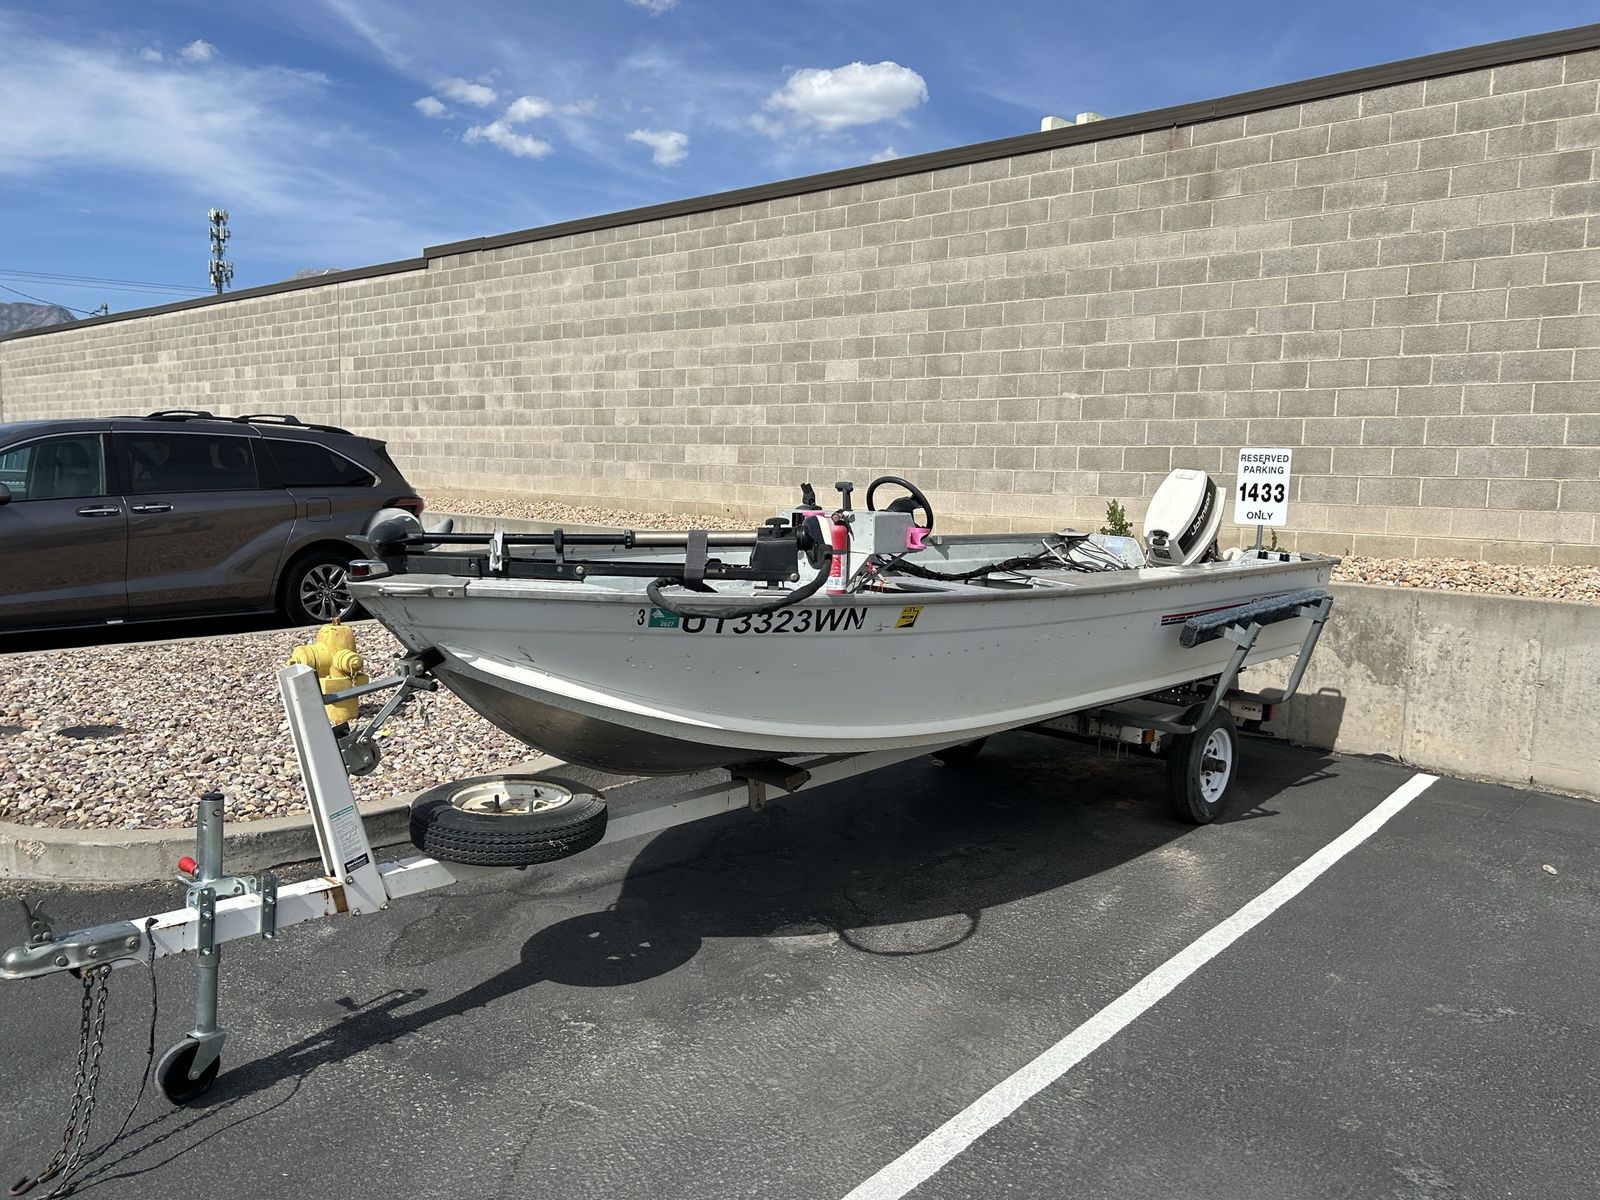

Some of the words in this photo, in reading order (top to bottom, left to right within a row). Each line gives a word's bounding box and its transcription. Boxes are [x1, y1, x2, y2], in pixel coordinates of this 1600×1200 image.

[1240, 454, 1289, 463] RESERVED
[1243, 465, 1284, 474] PARKING
[1239, 482, 1285, 503] 1433
[1191, 492, 1212, 536] Johnson
[1246, 511, 1273, 520] ONLY
[637, 608, 645, 626] 3
